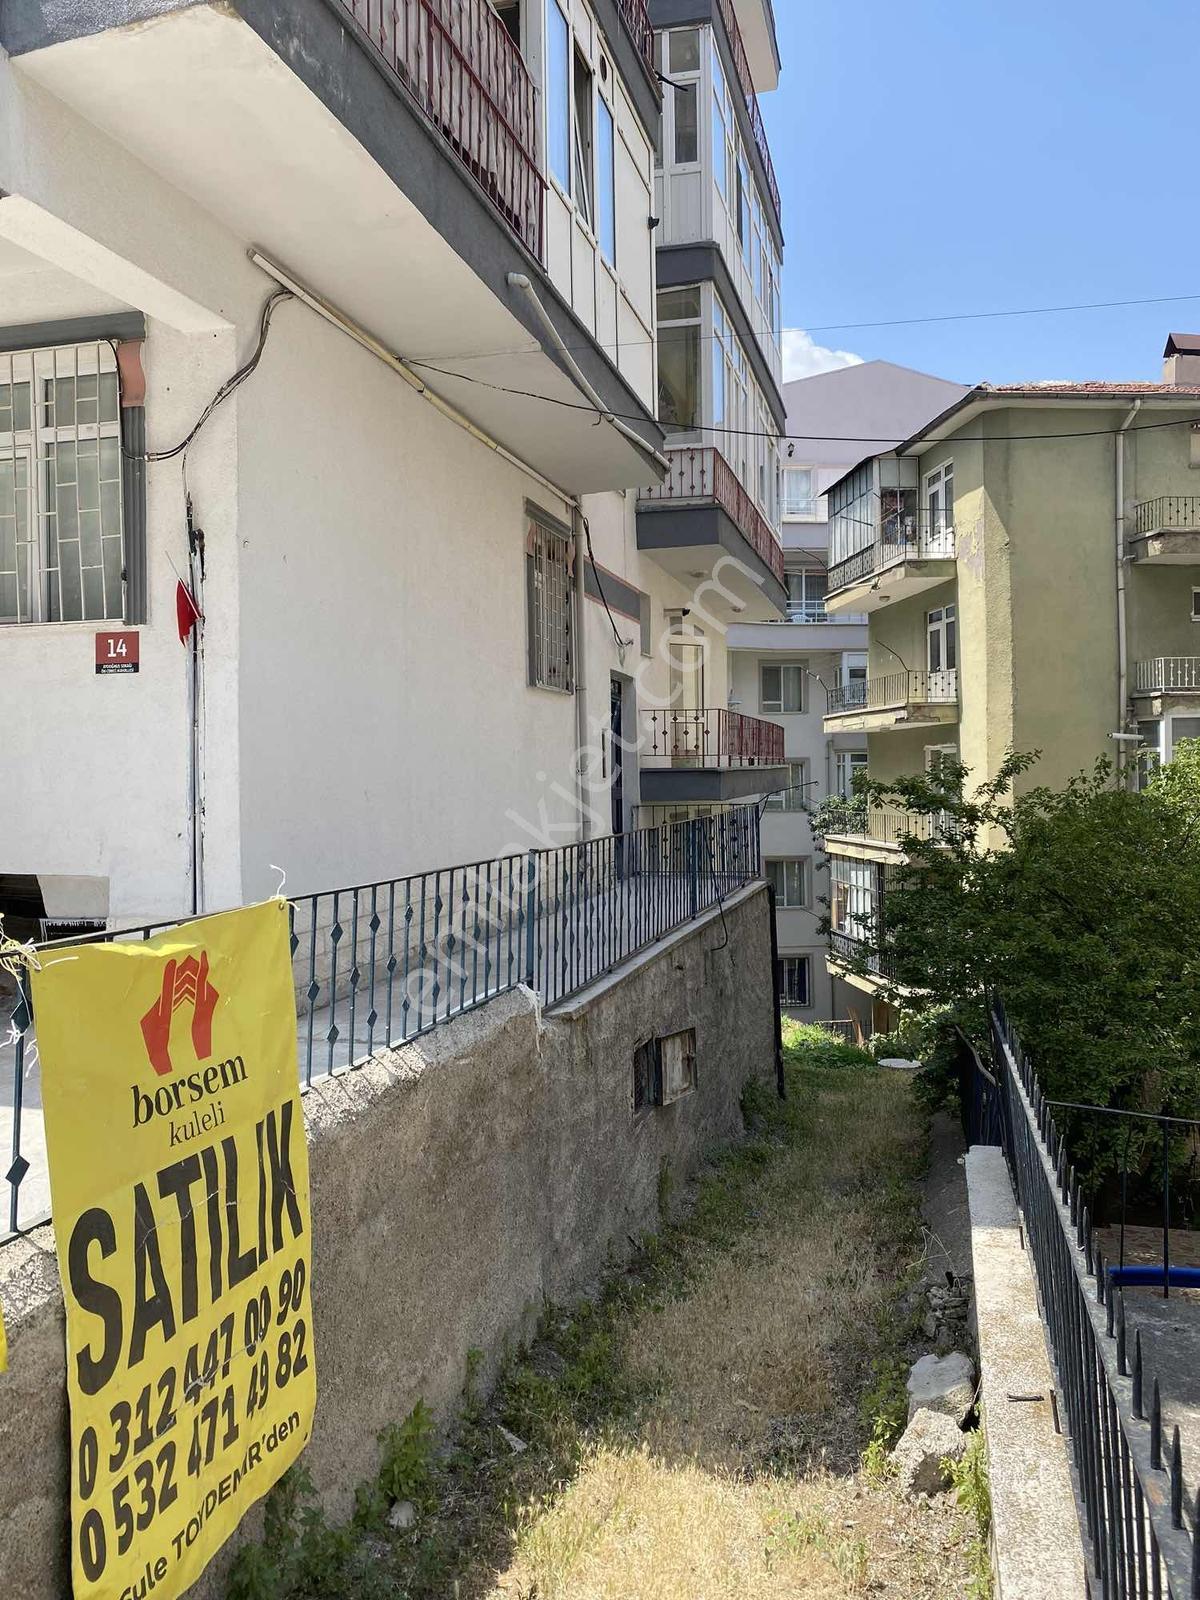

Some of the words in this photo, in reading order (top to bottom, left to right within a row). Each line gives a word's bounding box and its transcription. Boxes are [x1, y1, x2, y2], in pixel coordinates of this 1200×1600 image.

[107, 638, 127, 657] 14
[131, 1055, 248, 1128] borsem
[169, 1101, 226, 1147] kuleli
[68, 1100, 304, 1396] SATILIK
[79, 1426, 98, 1500] 0
[109, 1366, 177, 1473] 312
[183, 1312, 235, 1407] 447
[244, 1285, 272, 1357] 00
[276, 1257, 306, 1326] 90
[79, 1508, 106, 1583] 0
[112, 1440, 178, 1556] 532
[187, 1384, 239, 1479] 471
[246, 1350, 269, 1418] 49
[275, 1318, 308, 1389] 82
